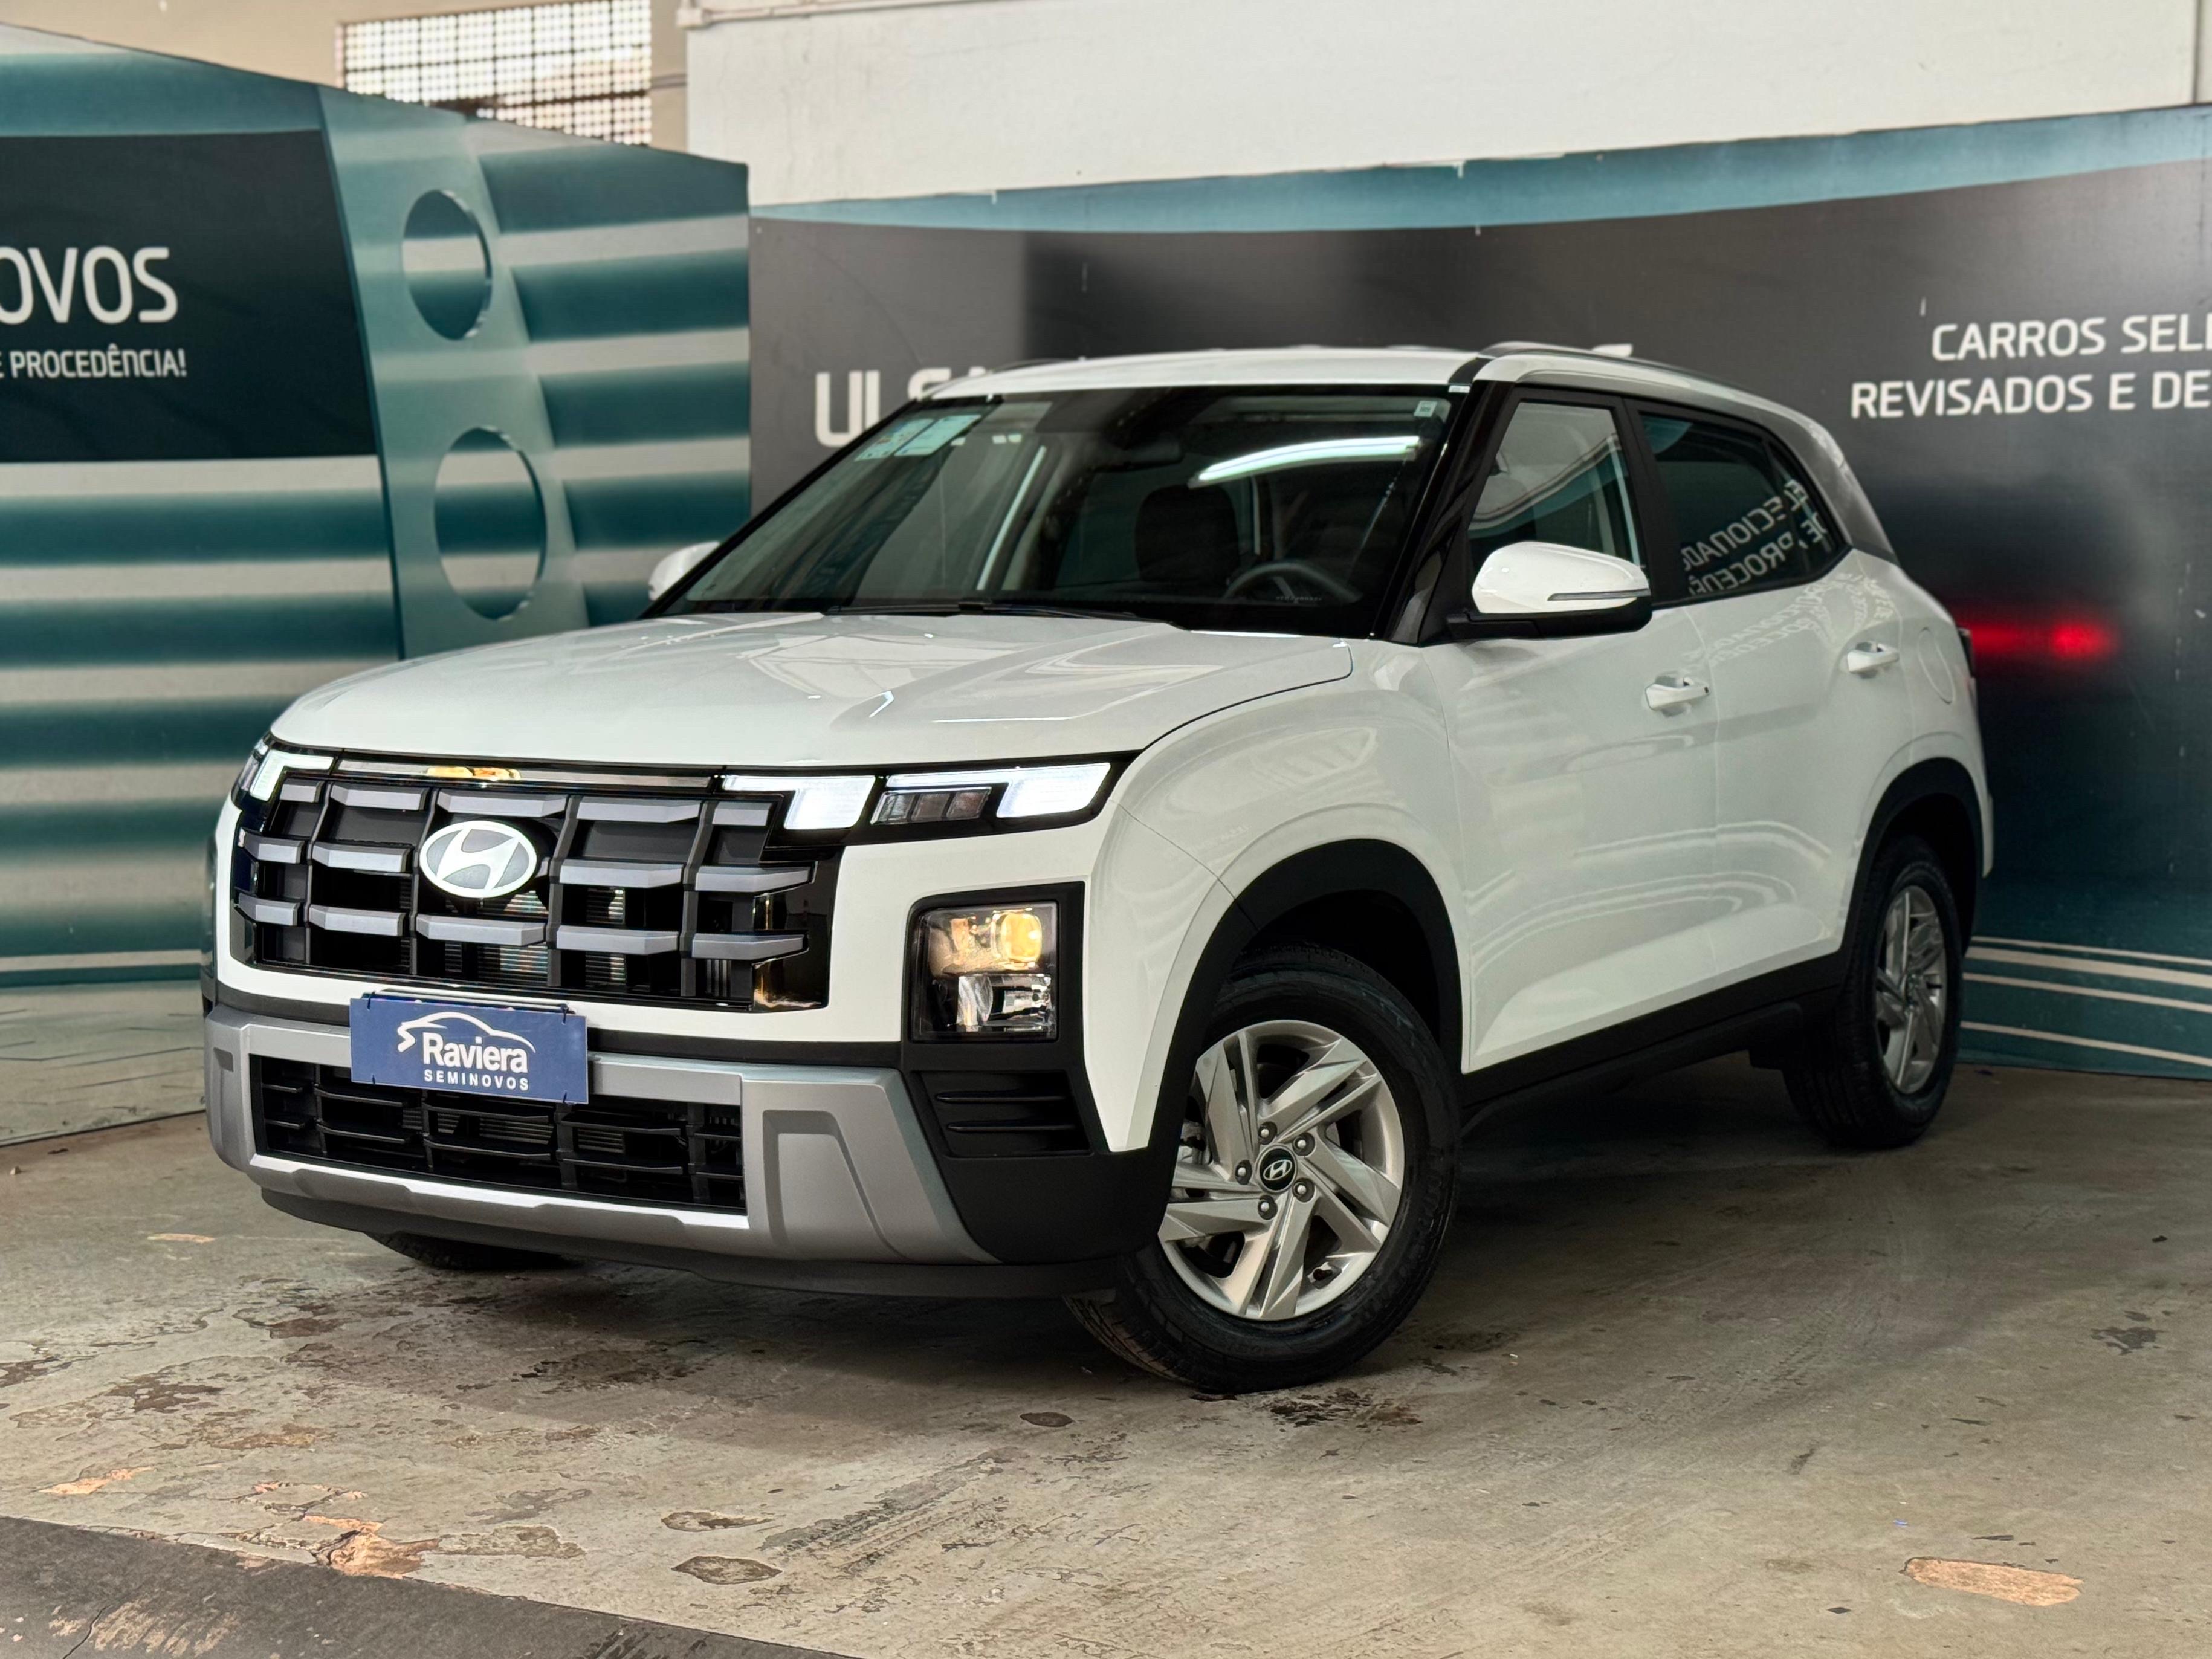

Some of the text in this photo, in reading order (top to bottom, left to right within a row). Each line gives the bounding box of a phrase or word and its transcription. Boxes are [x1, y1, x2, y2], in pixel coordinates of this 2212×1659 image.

[0, 246, 178, 325] OVOS
[1932, 312, 2212, 361] CARROS SEL
[8, 343, 187, 379] PROCEDÊNCIA!
[1851, 370, 2212, 419] REVISADOS E DE
[423, 1032, 528, 1073] Raviera
[424, 1069, 529, 1091] SEMINOVOS
